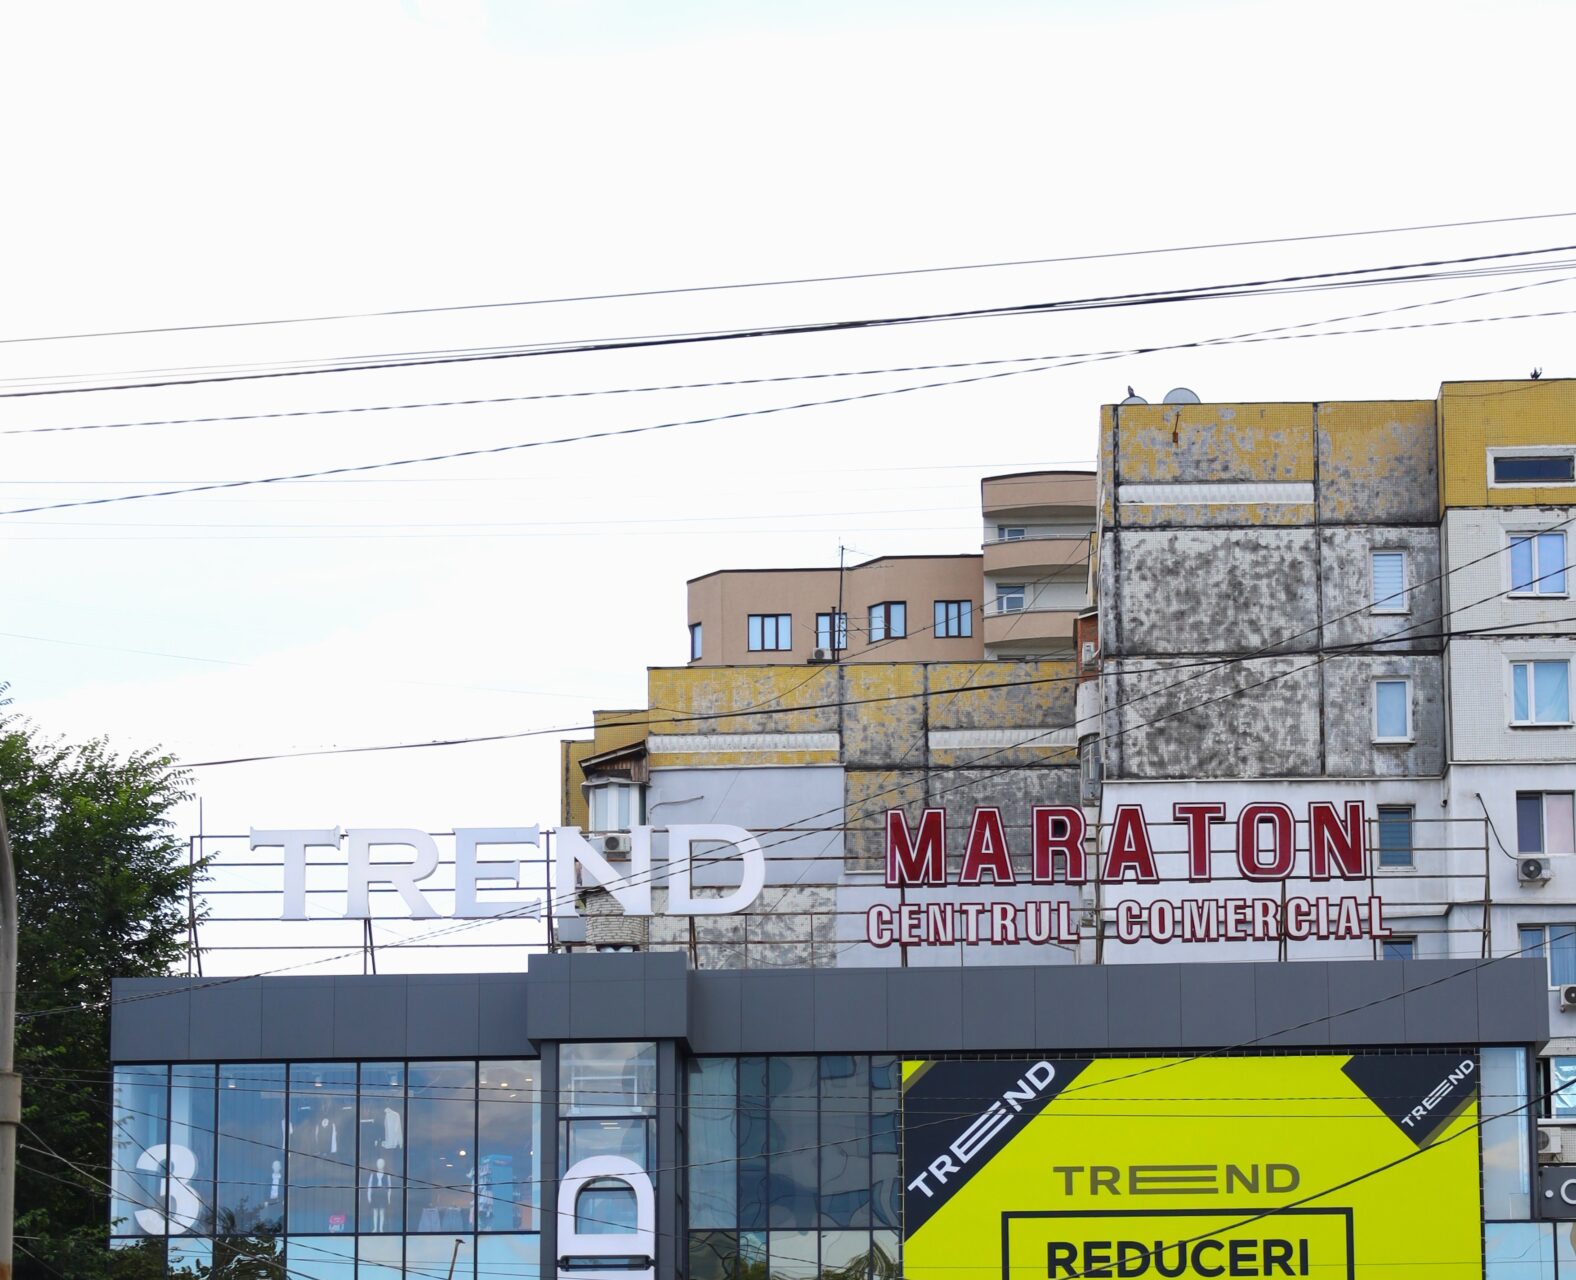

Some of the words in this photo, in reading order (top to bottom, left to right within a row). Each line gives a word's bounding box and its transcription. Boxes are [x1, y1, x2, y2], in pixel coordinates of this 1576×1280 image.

[250, 823, 766, 922] TREND
[885, 800, 1367, 888] MARATON
[867, 900, 1081, 948] CENTRUL
[1116, 895, 1393, 944] COMERCIAL
[907, 1060, 1056, 1198] TREND
[1401, 1059, 1475, 1128] TREND
[134, 1143, 200, 1236] 3
[1053, 1163, 1301, 1196] TREND
[1046, 1238, 1309, 1279] REDUCERI
